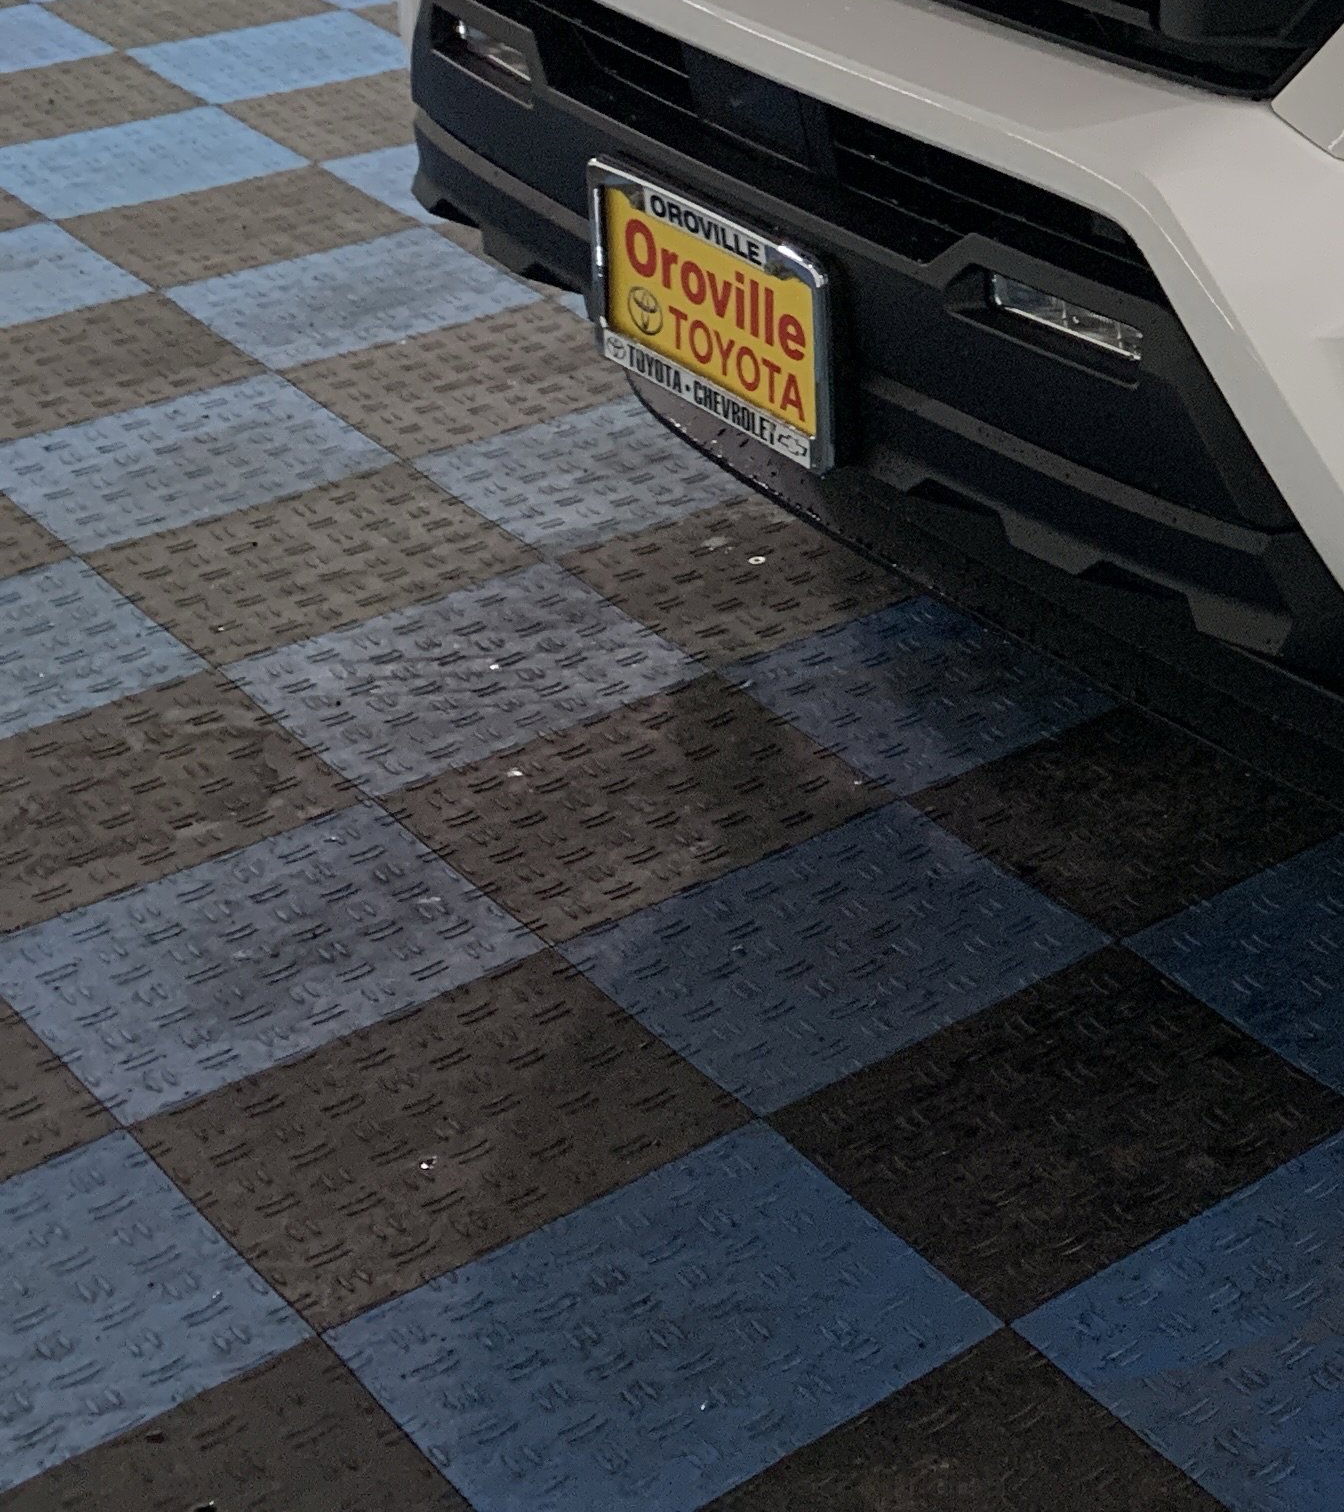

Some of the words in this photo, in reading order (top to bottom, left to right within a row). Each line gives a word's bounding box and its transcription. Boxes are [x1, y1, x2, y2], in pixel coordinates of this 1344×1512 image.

[650, 195, 763, 265] OROVILLE
[624, 218, 806, 362] Oroville
[626, 344, 683, 394] TOYOTA
[693, 380, 777, 446] CHEVROLET
[668, 305, 806, 422] TOYOTA
